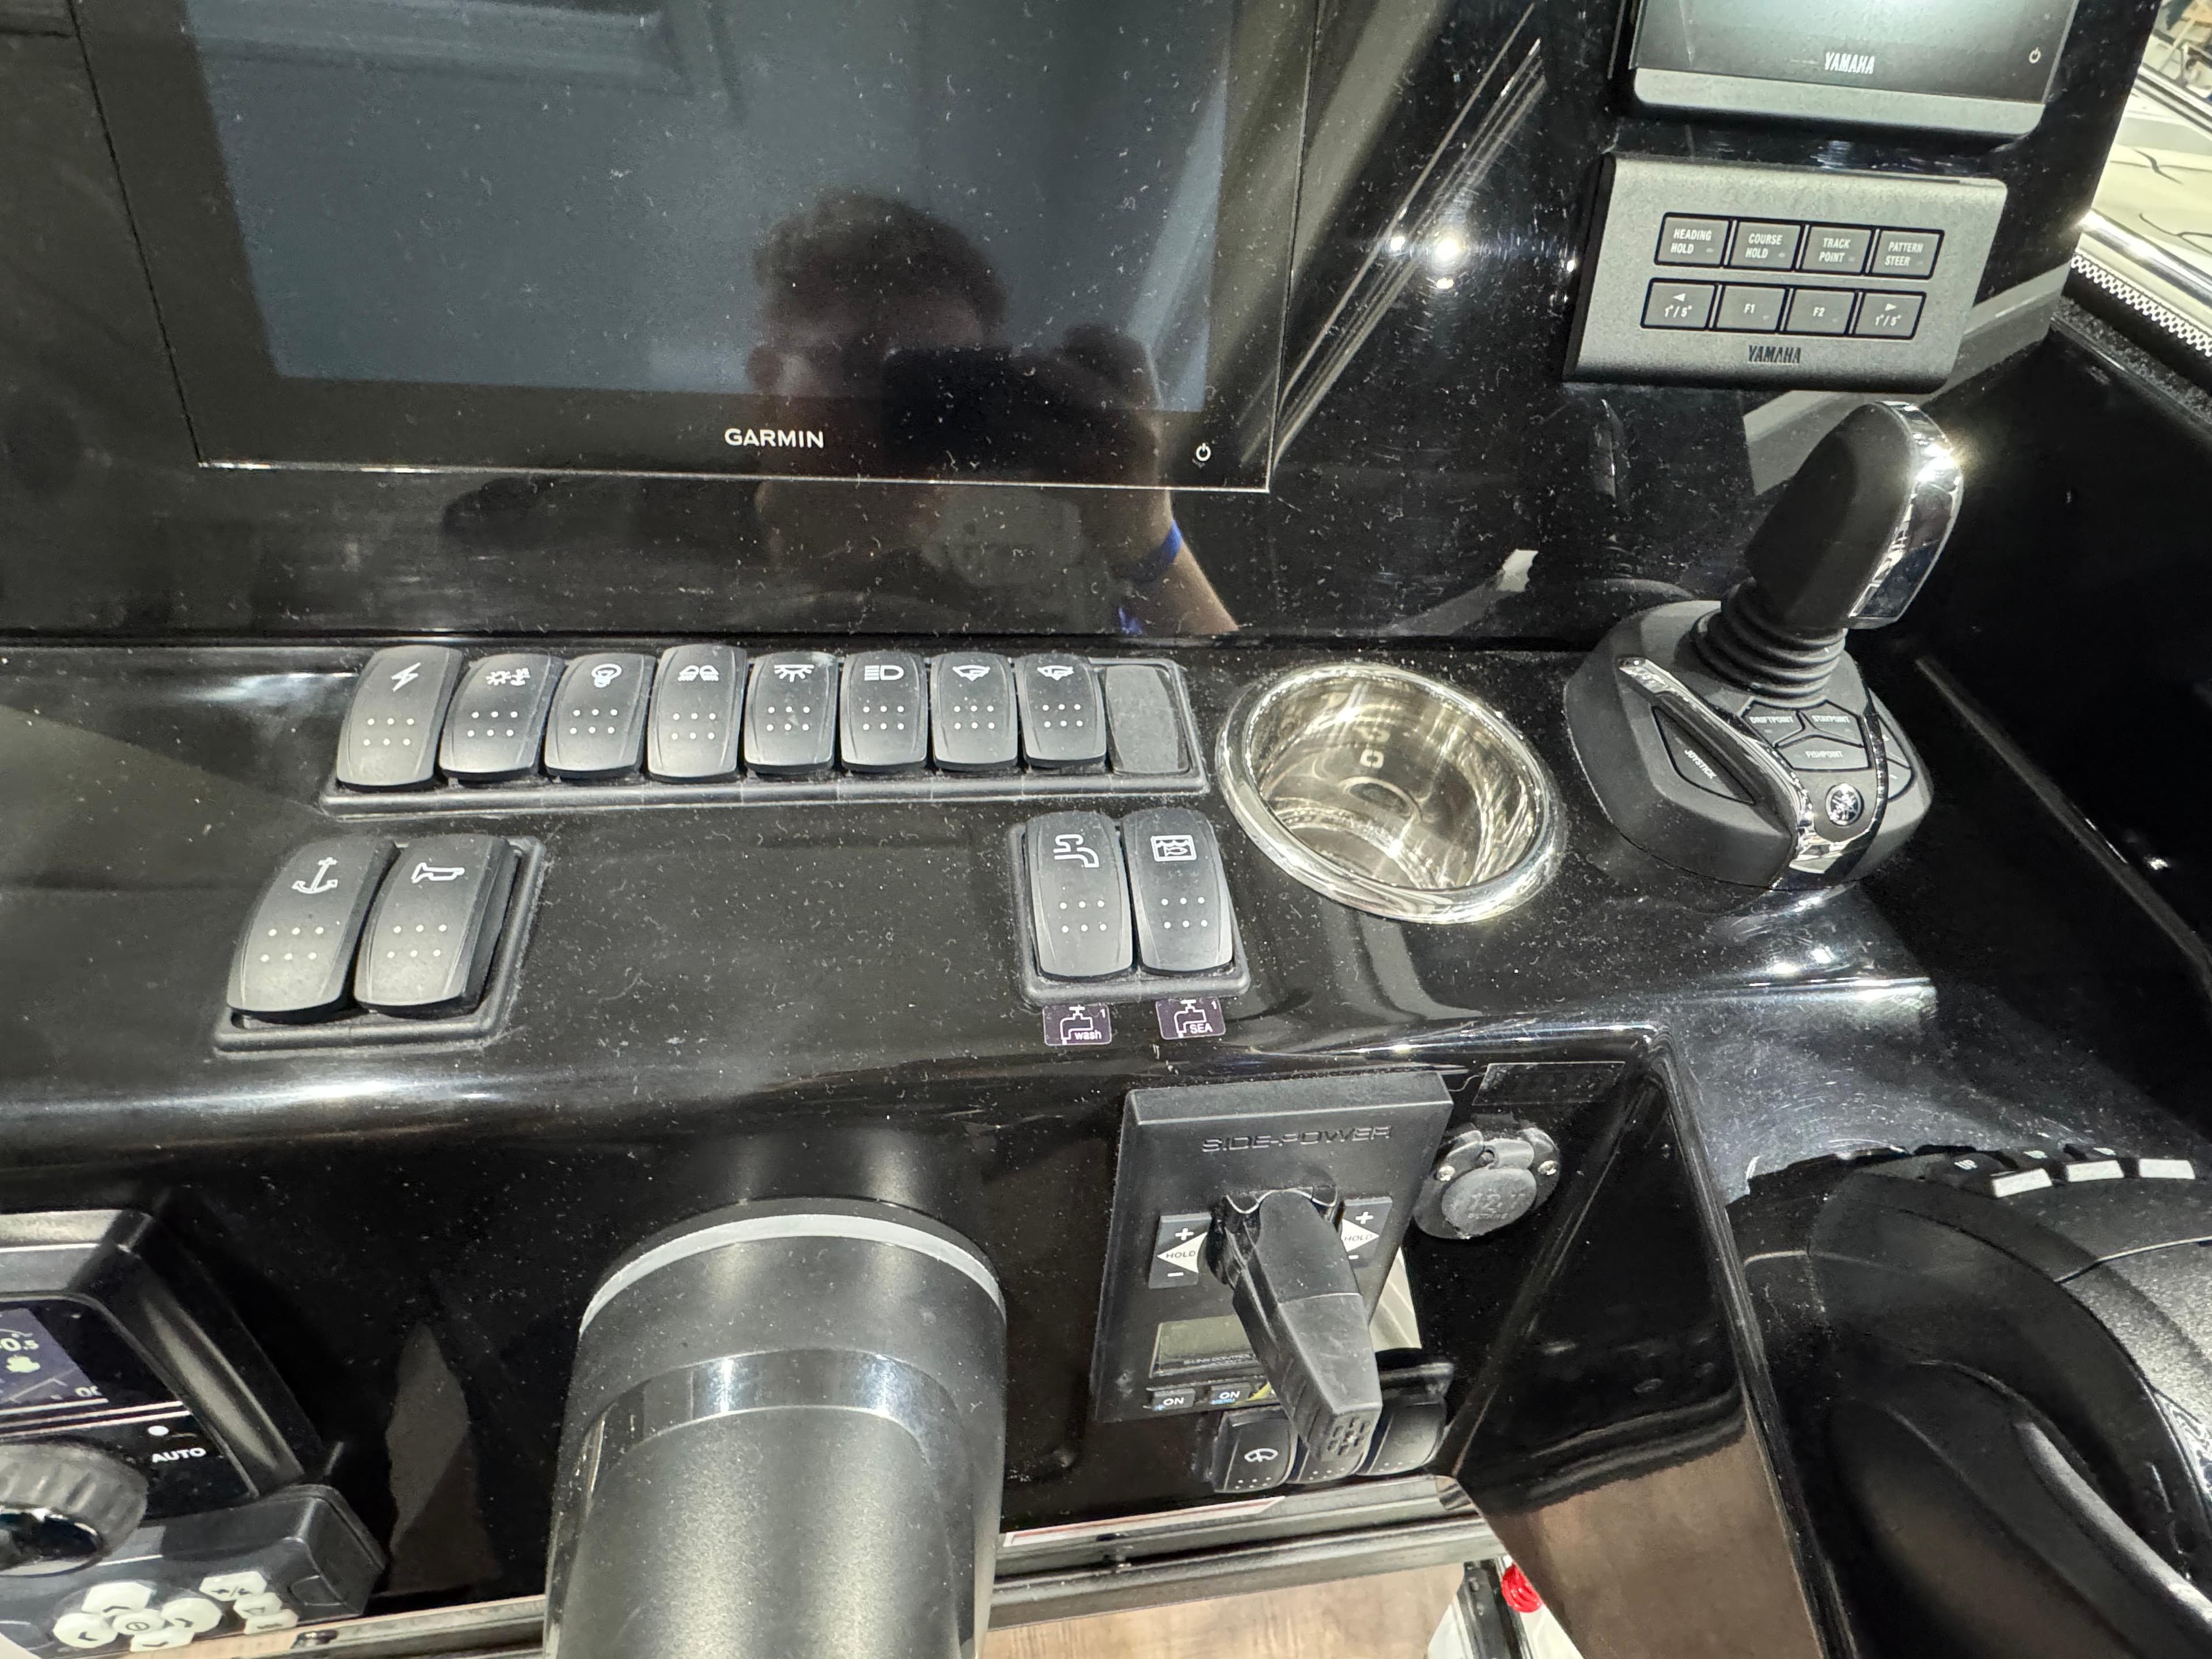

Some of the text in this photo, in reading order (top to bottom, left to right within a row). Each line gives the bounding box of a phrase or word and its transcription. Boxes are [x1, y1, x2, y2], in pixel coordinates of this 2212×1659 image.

[1825, 51, 1875, 74] YAMAHA
[1673, 228, 1712, 241] HEADING
[1748, 233, 1783, 245] COURSE
[1671, 243, 1694, 255] HOLD
[1823, 237, 1851, 249] TRACK
[1888, 242, 1924, 253] PATTERN
[1745, 247, 1768, 259] HOLD
[1819, 251, 1846, 263] POINT
[1884, 255, 1911, 267] STEER
[1744, 303, 1756, 314] F1
[1813, 306, 1825, 317] F2
[1748, 346, 1801, 363] YAMAHA
[725, 428, 824, 448] GARMIN
[1749, 715, 1794, 724] DRIFTPOINT
[1684, 749, 1718, 780] JOYSTICK
[1211, 1001, 1217, 1010] 1
[1100, 1009, 1106, 1018] 1
[1189, 1023, 1213, 1034] SEA
[1074, 1030, 1102, 1040] wash
[1202, 1125, 1391, 1153] SIDE-POWER
[1344, 1233, 1373, 1242] HOLD
[1165, 1251, 1196, 1259] HOLD
[1163, 1396, 1184, 1406] ON
[1219, 1391, 1240, 1399] ON
[151, 1446, 207, 1464] AUTO
